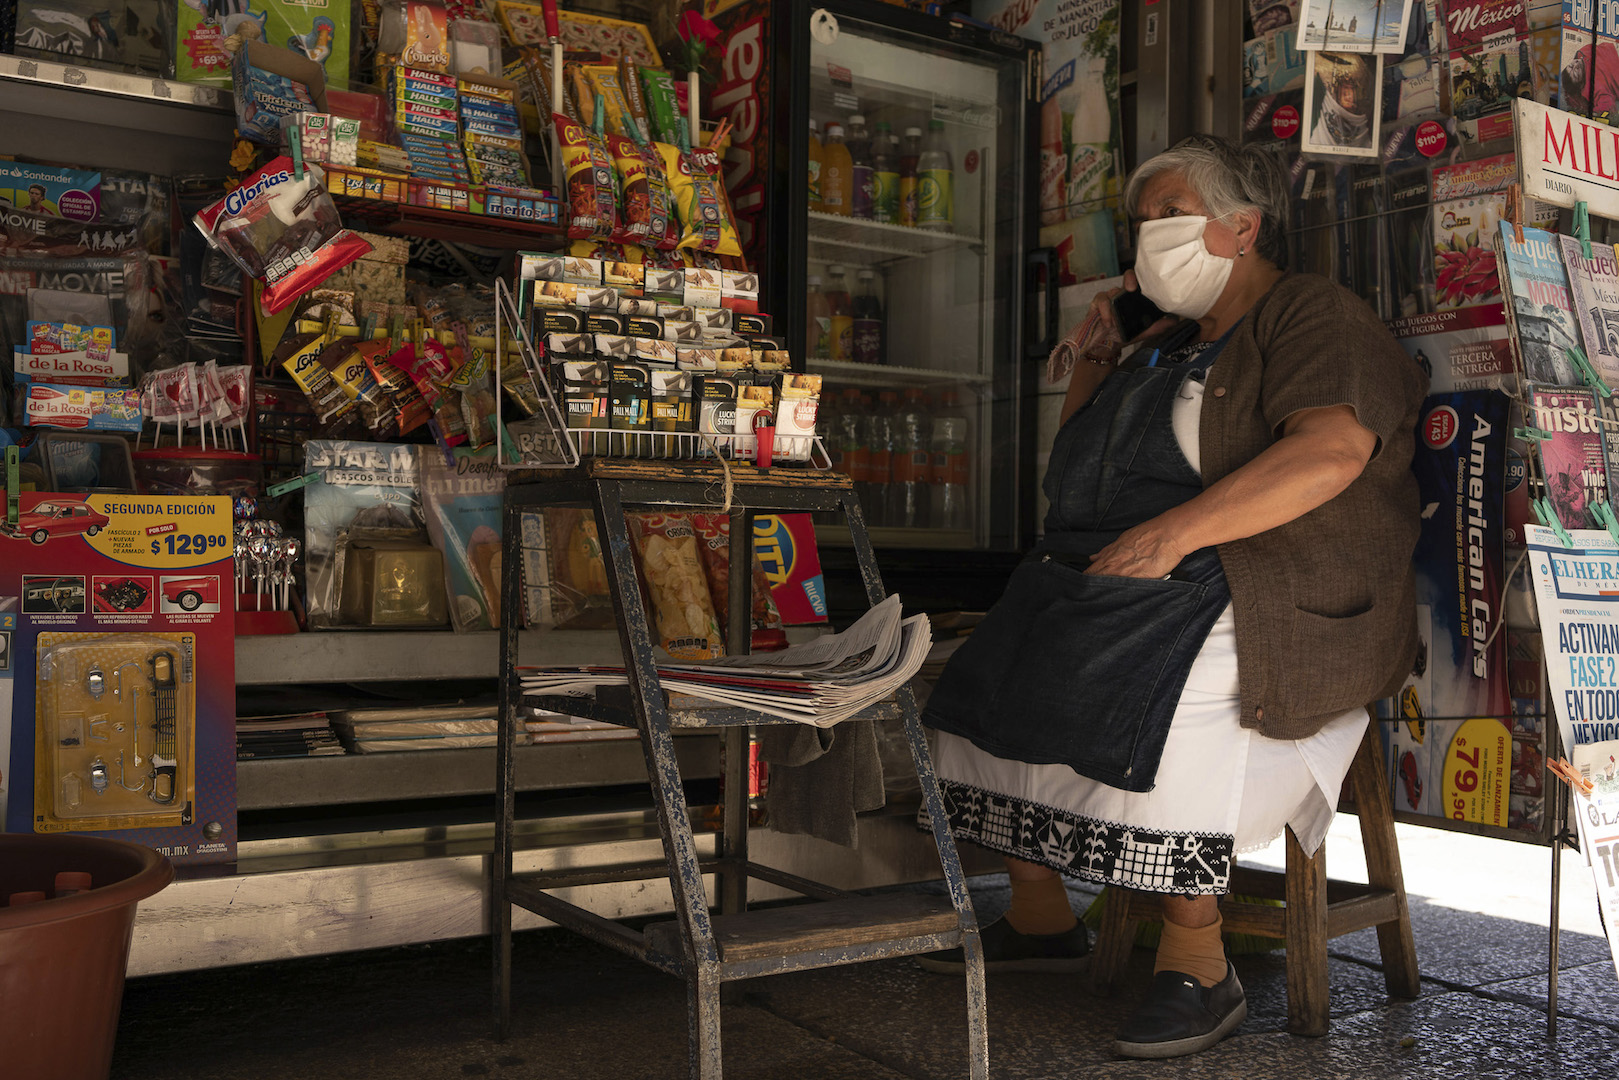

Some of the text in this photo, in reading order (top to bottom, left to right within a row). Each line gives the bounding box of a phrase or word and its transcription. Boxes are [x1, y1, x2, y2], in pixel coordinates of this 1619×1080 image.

[1044, 20, 1056, 32] DE
[1059, 1, 1114, 26] MANANTIAL
[1448, 2, 1524, 35] México
[1052, 16, 1098, 41] CON JUGO
[1488, 34, 1514, 49] 2020
[404, 45, 448, 66] Conejos
[410, 70, 441, 82] HALLS
[412, 82, 442, 93] HALLS
[470, 84, 499, 95] HALLS
[410, 92, 441, 104] HALLS
[468, 97, 490, 106] HALLS
[410, 104, 441, 116] HALLS
[473, 110, 498, 120] HALLS
[1247, 101, 1268, 132] NUEVA
[412, 116, 442, 127] HALLS
[468, 122, 496, 132] HALLS
[410, 126, 441, 138] HALLS
[480, 136, 508, 146] HALLS
[1384, 131, 1404, 159] NUEVA
[24, 170, 72, 184] Santander
[226, 170, 288, 215] Glorias
[1545, 178, 1572, 196] DIARIO
[490, 203, 543, 220] mentos
[1536, 213, 1540, 221] 2
[1541, 212, 1546, 220] X
[1396, 312, 1457, 328] DE JUEGOS CON
[1400, 324, 1445, 336] DE FIGURAS
[30, 358, 114, 374] de la Rosa
[1450, 352, 1496, 366] TERCERA
[1451, 362, 1502, 376] ENTREGA!
[29, 402, 91, 415] de la Rosa
[568, 402, 592, 413] PALL MALL
[612, 406, 638, 416] PALL MALL
[656, 408, 678, 417] PALL MALL
[798, 406, 817, 414] LUCKY
[1431, 414, 1440, 442] 1/43
[312, 450, 388, 469] STAR
[334, 472, 373, 482] CASCOS
[1456, 456, 1466, 493] Colecciona
[1456, 494, 1464, 504] los
[104, 502, 216, 514] SEGUNDA EDICIÓN
[1456, 506, 1464, 530] muscle
[1456, 532, 1464, 546] cars
[1592, 539, 1600, 547] DE
[1468, 413, 1492, 680] American Cars
[1456, 548, 1465, 563] más
[1552, 559, 1573, 578] EL
[1457, 564, 1466, 592] famosos
[804, 580, 825, 614] nuevo
[1458, 593, 1467, 612] made
[4, 616, 12, 626] 2
[1460, 622, 1469, 636] USA
[1569, 656, 1617, 688] FASE 2
[1515, 679, 1536, 694] AD
[1565, 690, 1586, 721] EN
[1496, 736, 1504, 765] OFERTA
[1496, 767, 1503, 778] DE
